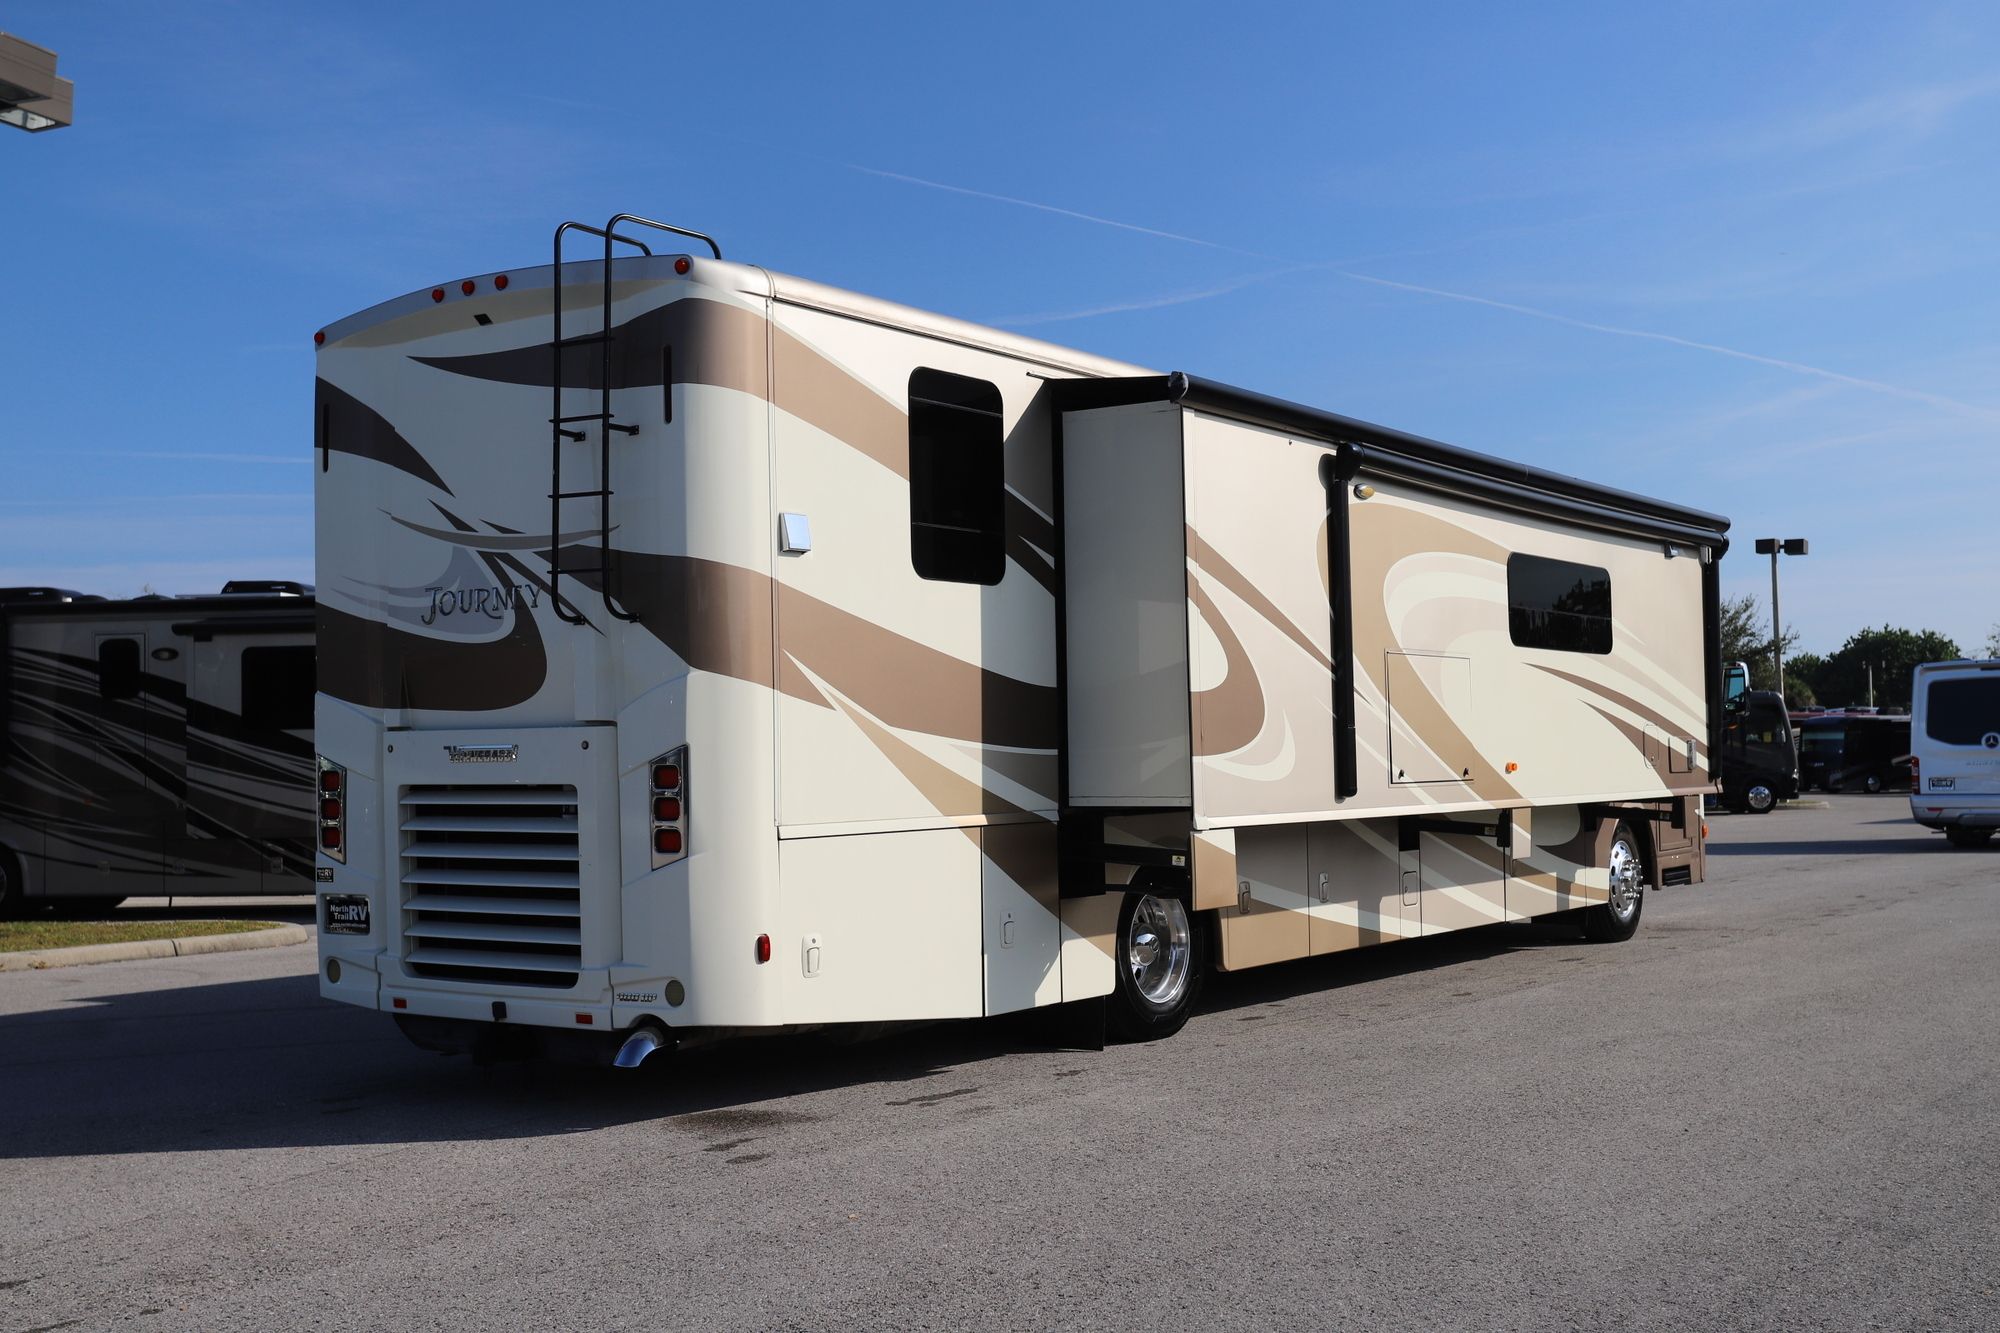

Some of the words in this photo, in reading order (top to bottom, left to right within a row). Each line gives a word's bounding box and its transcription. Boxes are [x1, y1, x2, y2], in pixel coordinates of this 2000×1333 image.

[421, 583, 543, 625] JOURNEY
[330, 904, 349, 913] North
[349, 905, 368, 921] RV
[334, 912, 349, 921] Trail
